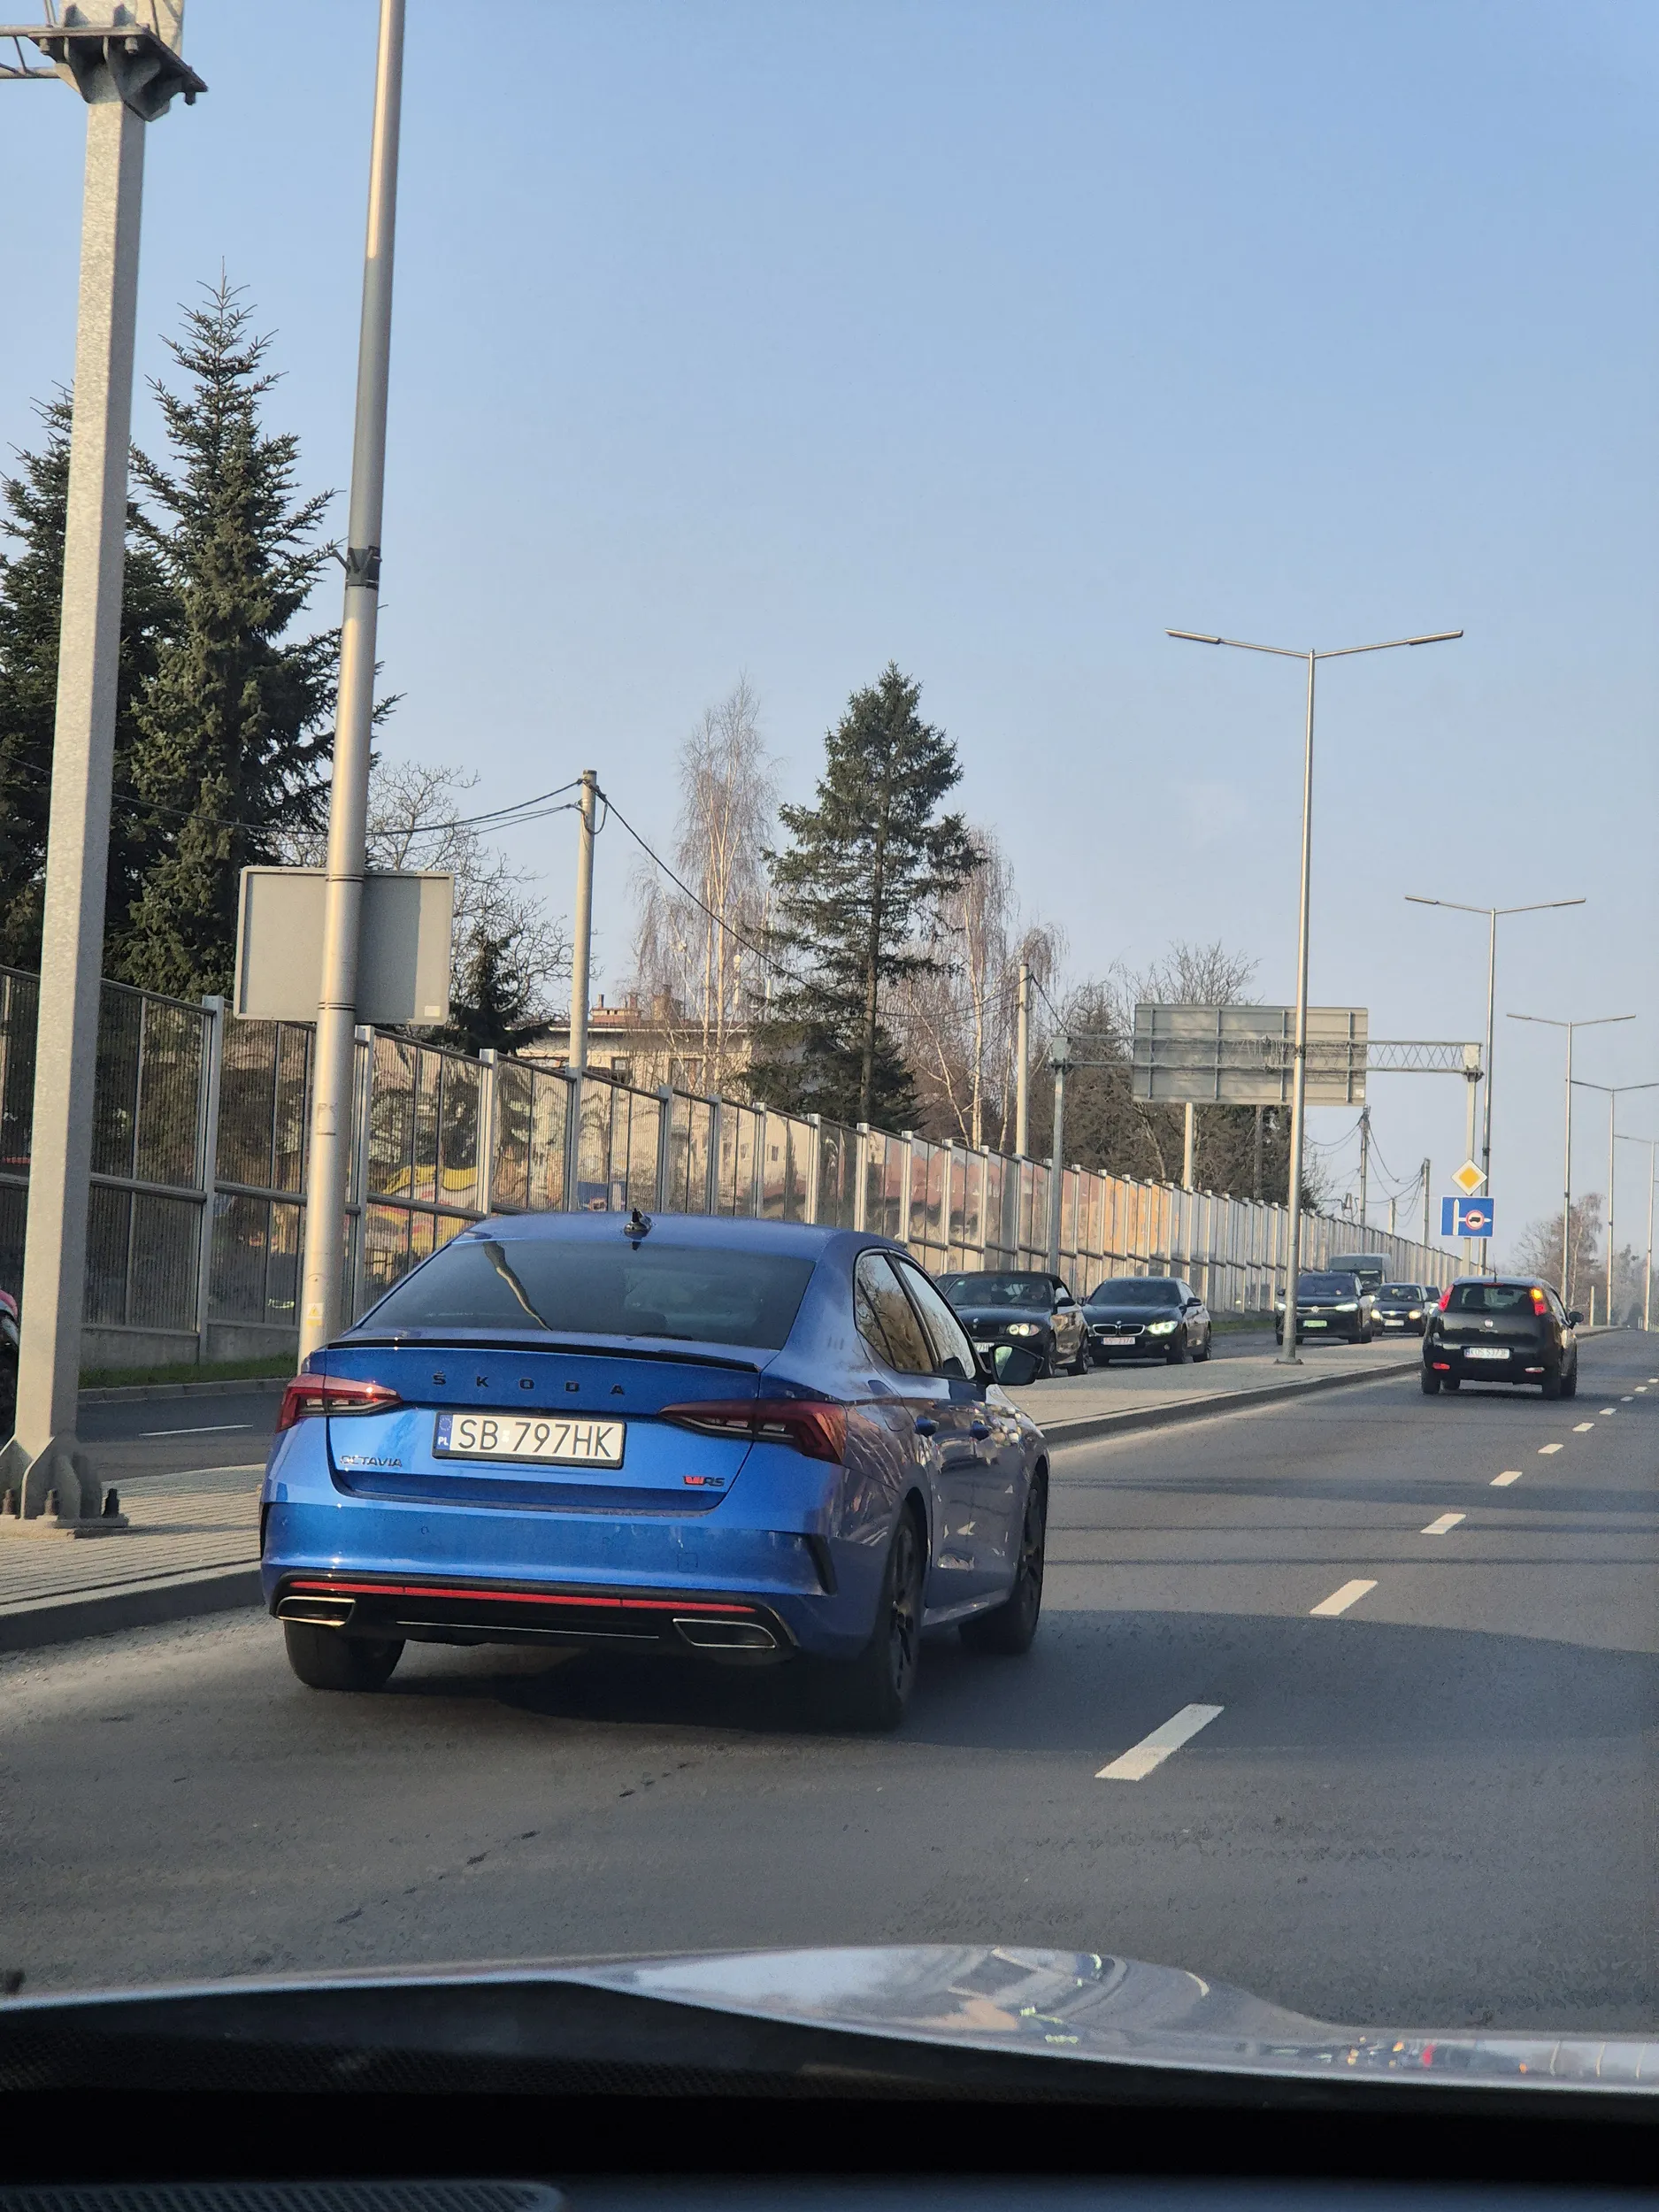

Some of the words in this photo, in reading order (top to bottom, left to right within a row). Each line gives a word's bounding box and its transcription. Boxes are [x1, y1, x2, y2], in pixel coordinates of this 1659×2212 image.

[433, 1371, 626, 1396] ŠKODA
[437, 1436, 449, 1446] PL
[457, 1419, 499, 1451] SB
[512, 1421, 615, 1458] 797HK
[340, 1455, 403, 1468] OCTAVIA
